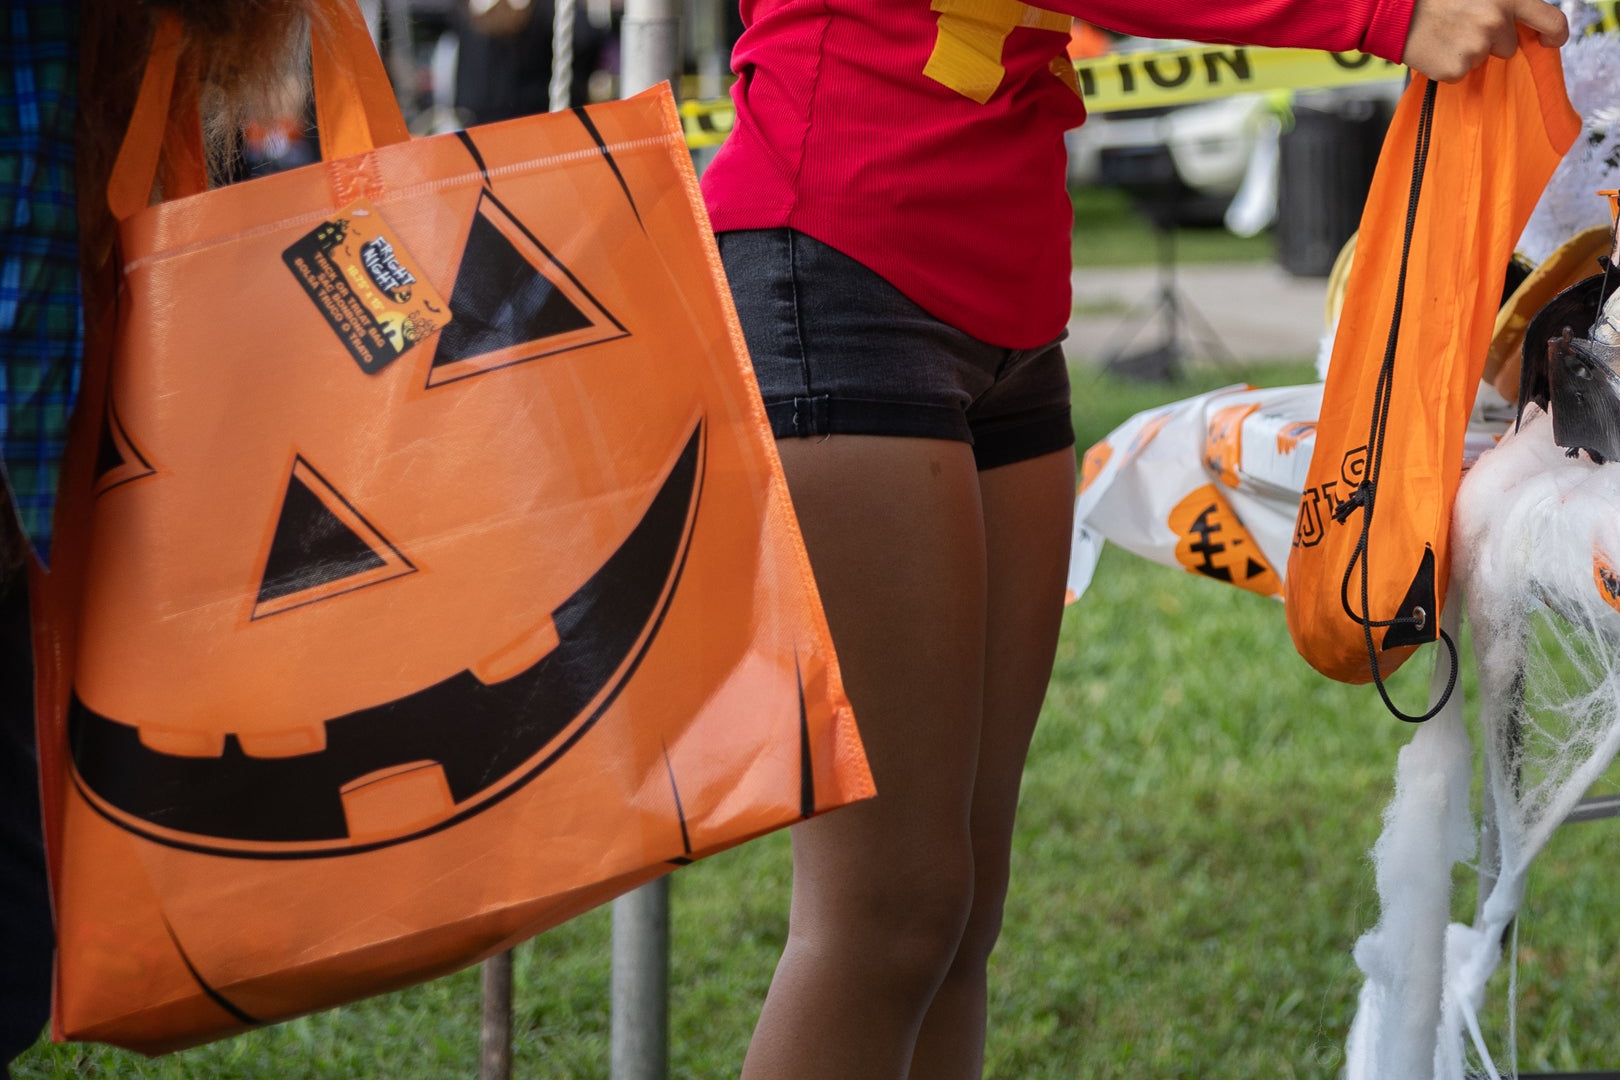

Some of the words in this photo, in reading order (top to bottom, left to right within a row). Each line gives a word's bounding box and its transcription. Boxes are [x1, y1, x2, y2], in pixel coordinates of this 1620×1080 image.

[363, 247, 399, 291] NIGHT
[370, 235, 416, 286] FRIGHT
[315, 251, 338, 281] TRICK
[336, 281, 349, 297] OR
[348, 297, 371, 326] TREAT
[368, 327, 385, 348] BAG
